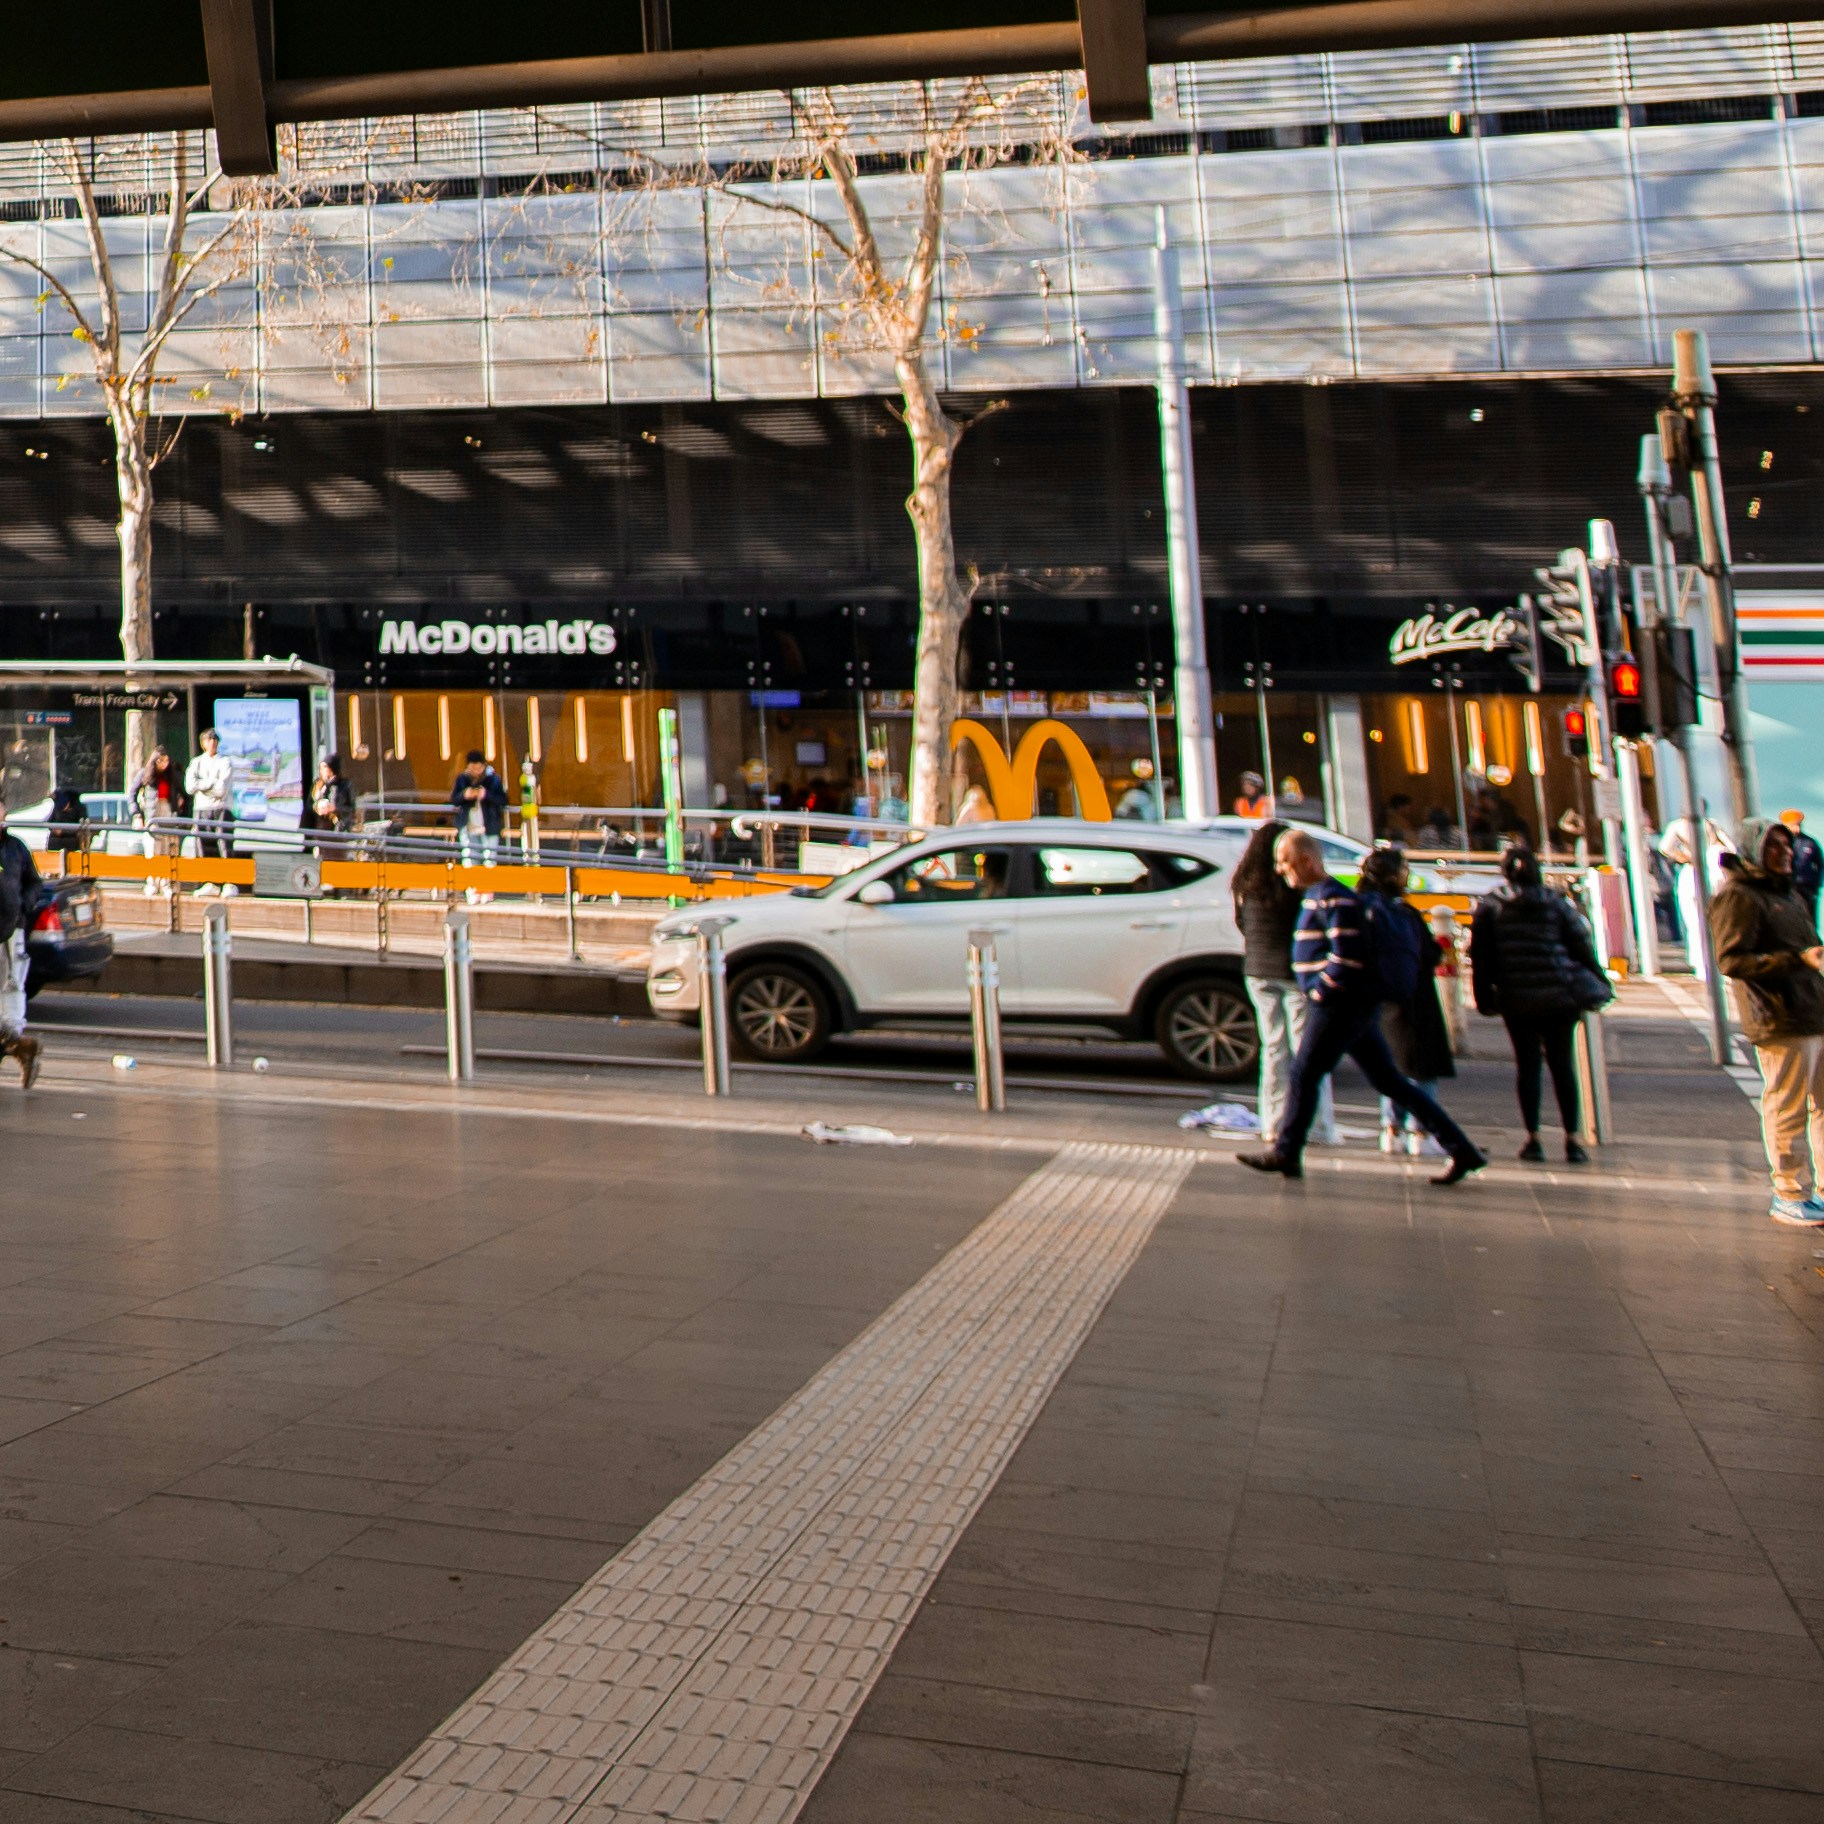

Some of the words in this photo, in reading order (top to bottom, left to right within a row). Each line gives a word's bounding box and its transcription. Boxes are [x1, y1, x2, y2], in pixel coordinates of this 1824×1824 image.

[379, 619, 617, 654] McDonald's
[107, 693, 135, 707] From
[138, 693, 160, 709] City
